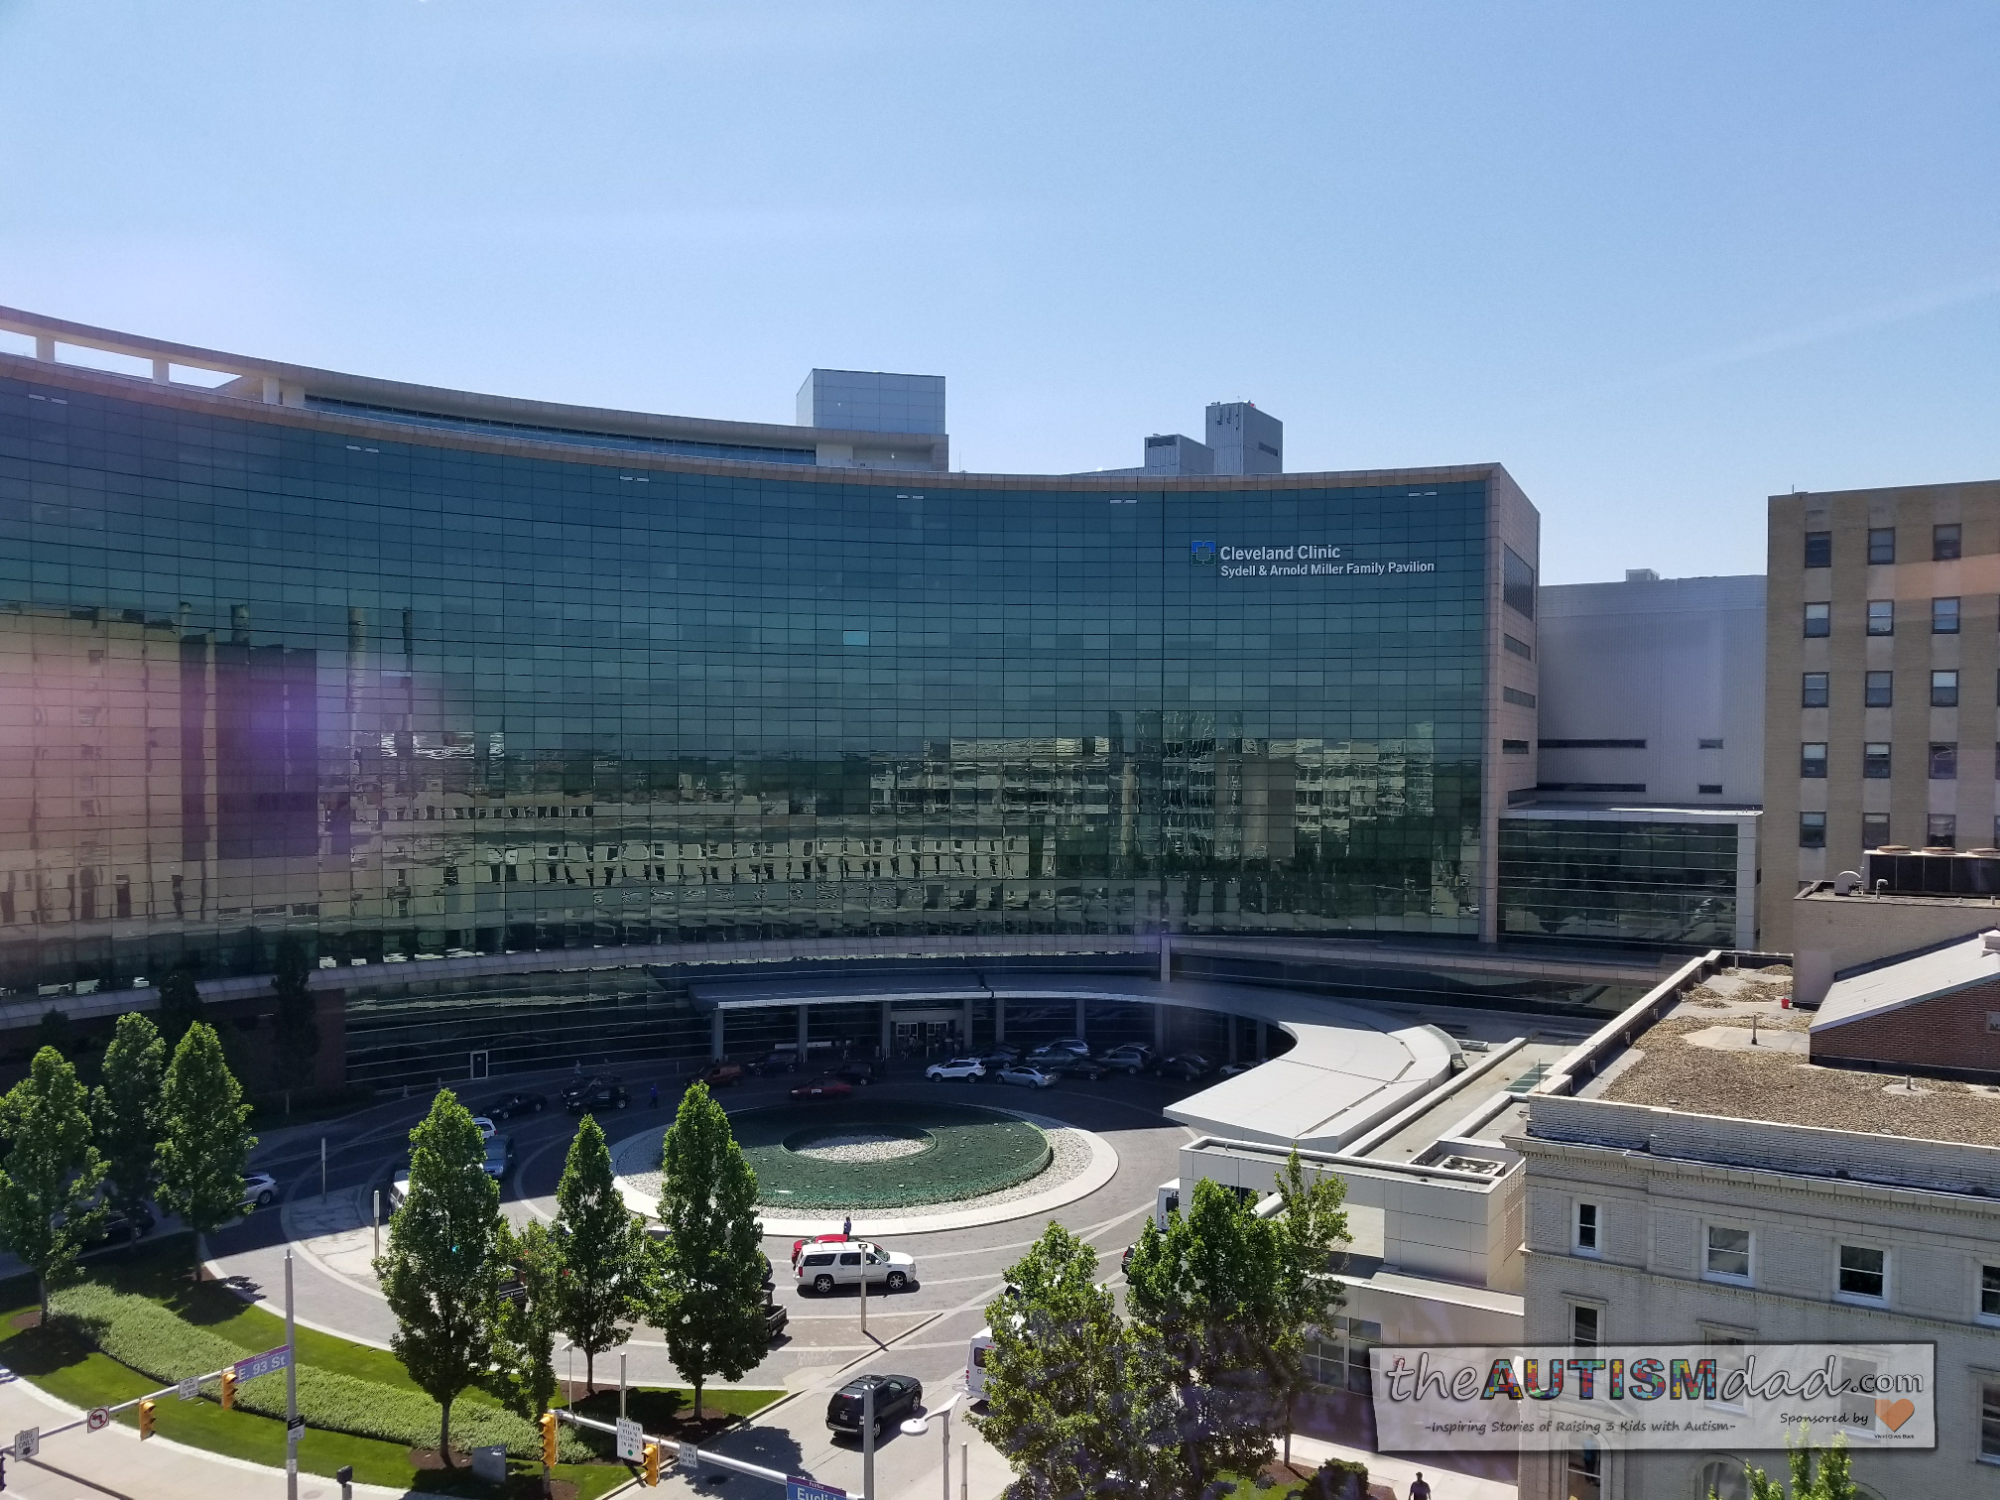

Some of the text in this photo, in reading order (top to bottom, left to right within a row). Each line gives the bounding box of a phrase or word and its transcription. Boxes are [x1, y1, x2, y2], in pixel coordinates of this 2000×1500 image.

[1220, 544, 1341, 560] Cleveland Clinic
[1220, 561, 1435, 578] Sydell & Arnold Miller Family Pavilion
[238, 1367, 250, 1380] E.
[253, 1361, 268, 1375] 93
[271, 1355, 286, 1368] St
[18, 1437, 35, 1449] ONLY
[19, 1431, 33, 1441] BUS
